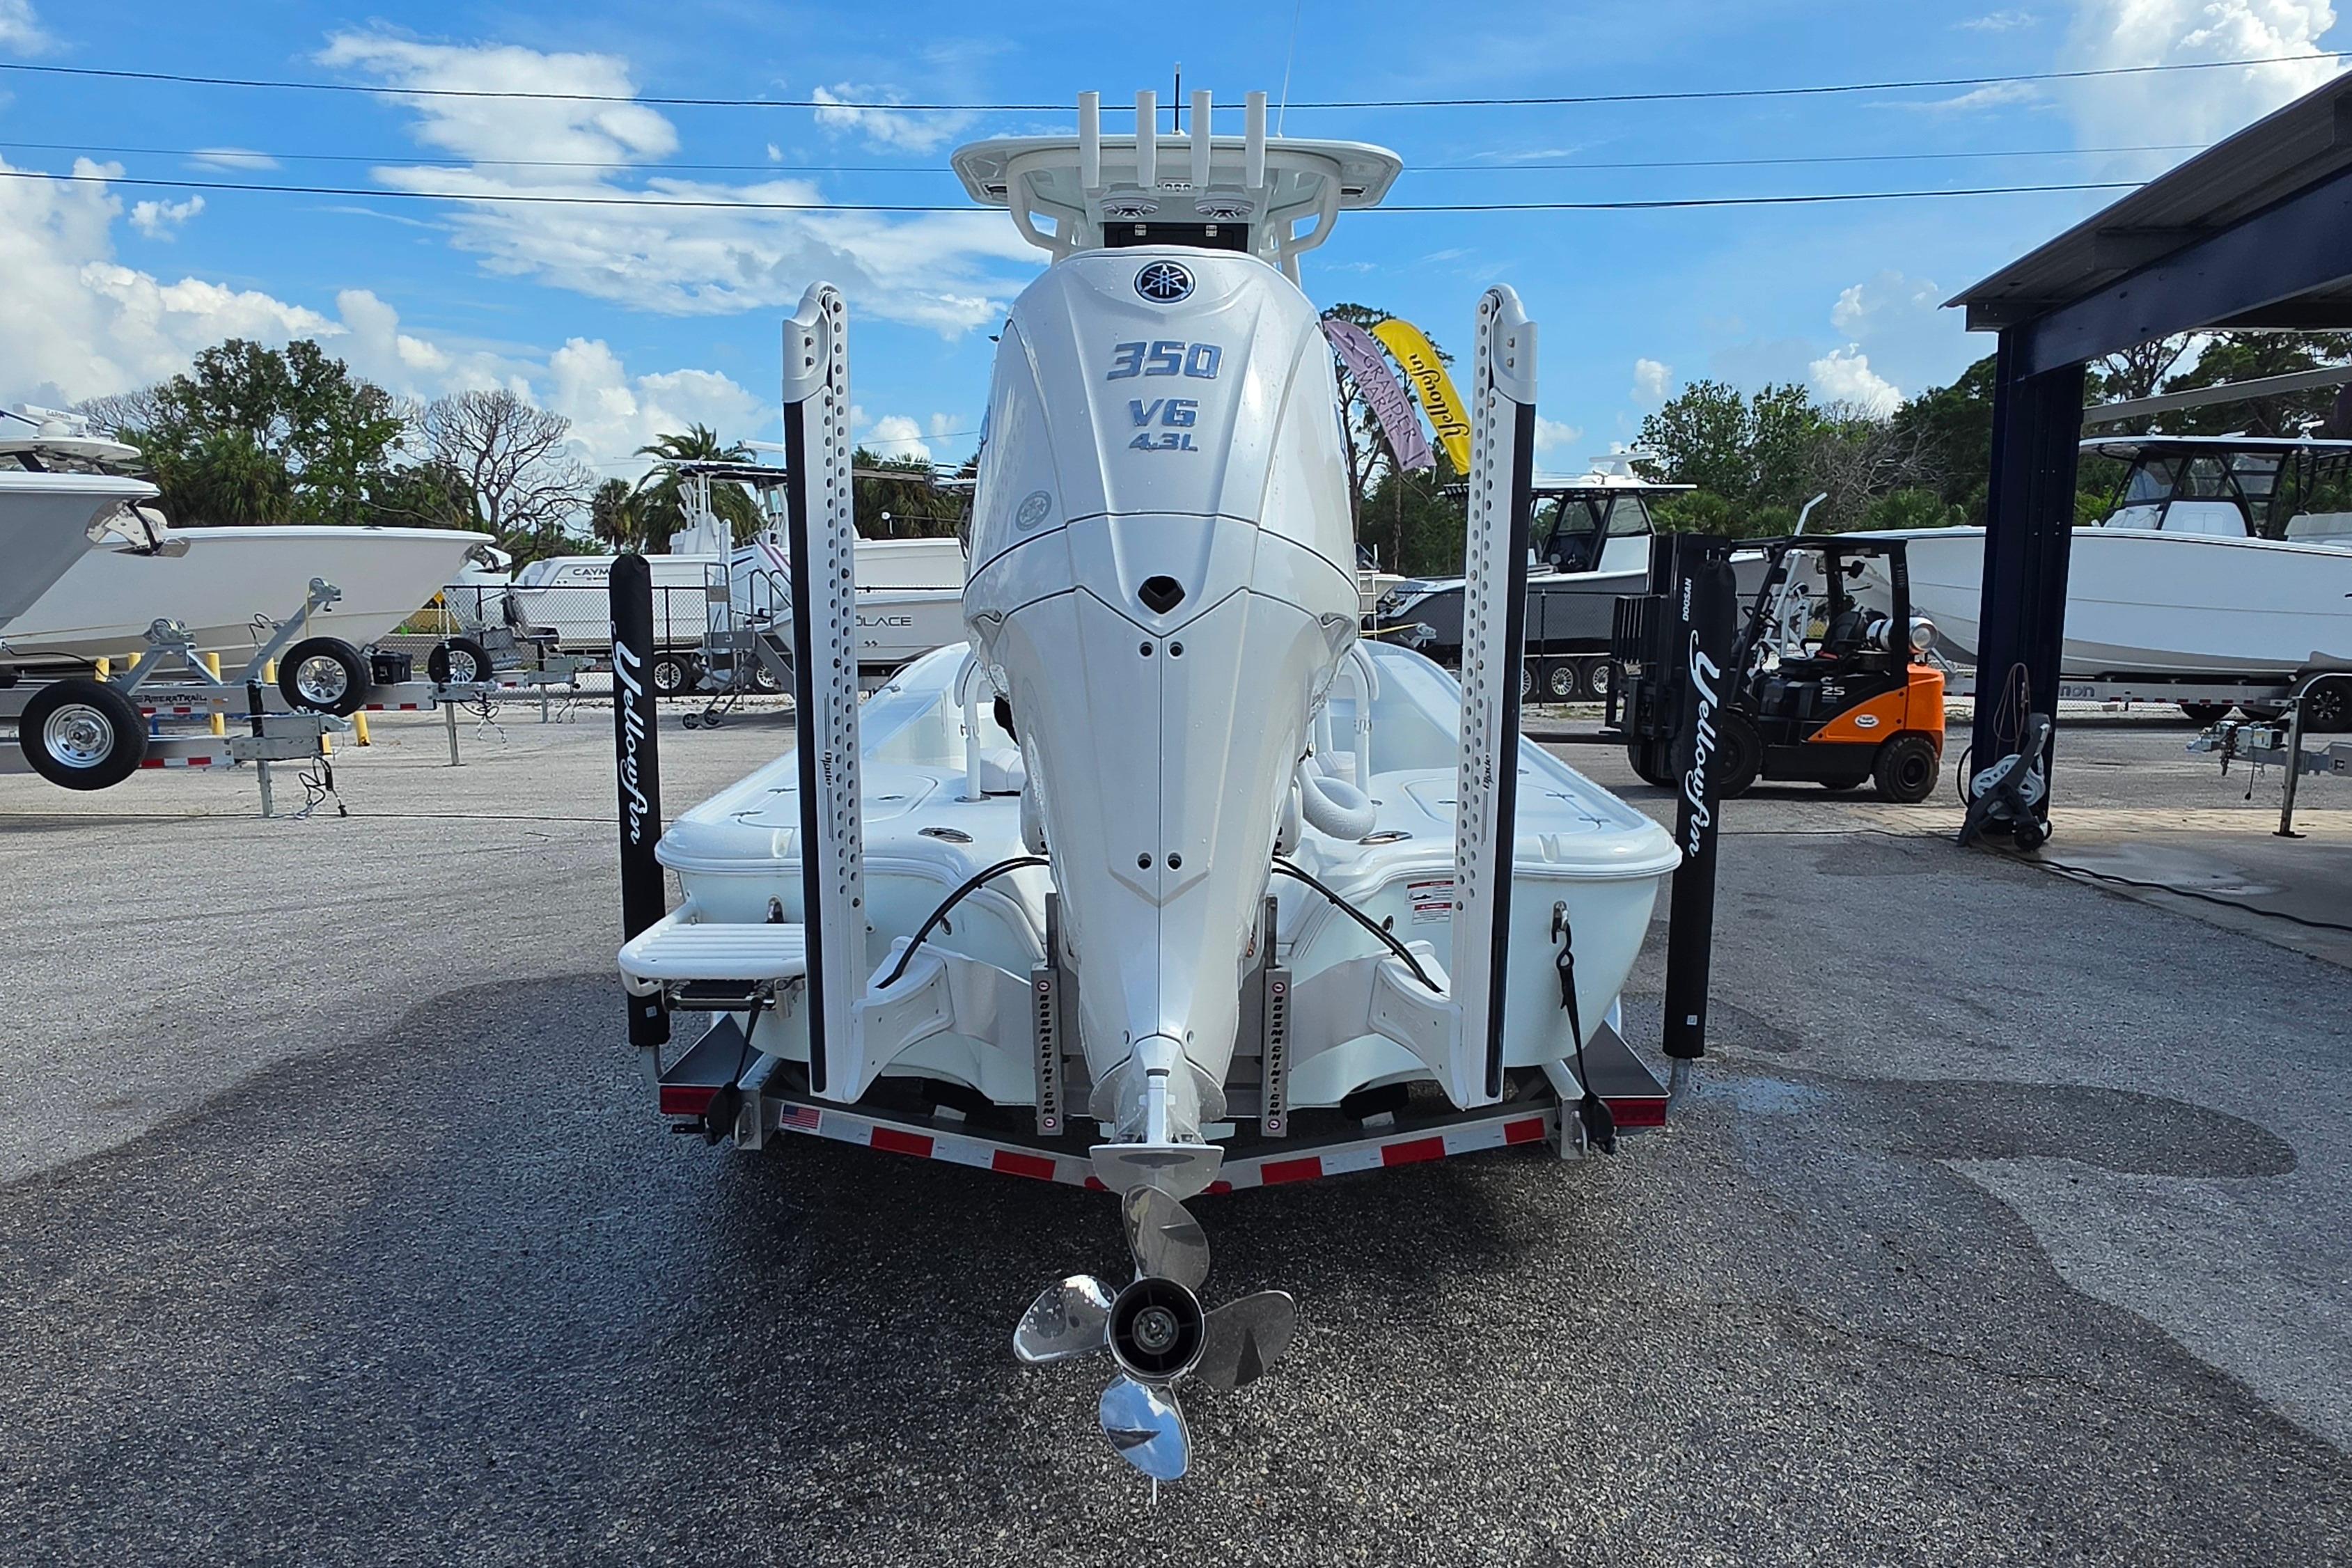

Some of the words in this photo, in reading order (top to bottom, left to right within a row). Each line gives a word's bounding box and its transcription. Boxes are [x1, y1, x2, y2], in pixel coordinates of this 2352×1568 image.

[1106, 340, 1223, 381] 350
[1129, 398, 1199, 428] V6
[1357, 370, 1400, 440] MARINE
[1363, 354, 1417, 443] GRANDER
[1409, 353, 1471, 438] Yellowfin
[1129, 432, 1198, 452] 4.3L
[855, 616, 912, 627] OLACE
[1682, 577, 1692, 622] DOOSAN
[1821, 687, 1846, 696] 25
[611, 620, 648, 845] Yellowfin
[1685, 629, 1720, 858] Yellowfin
